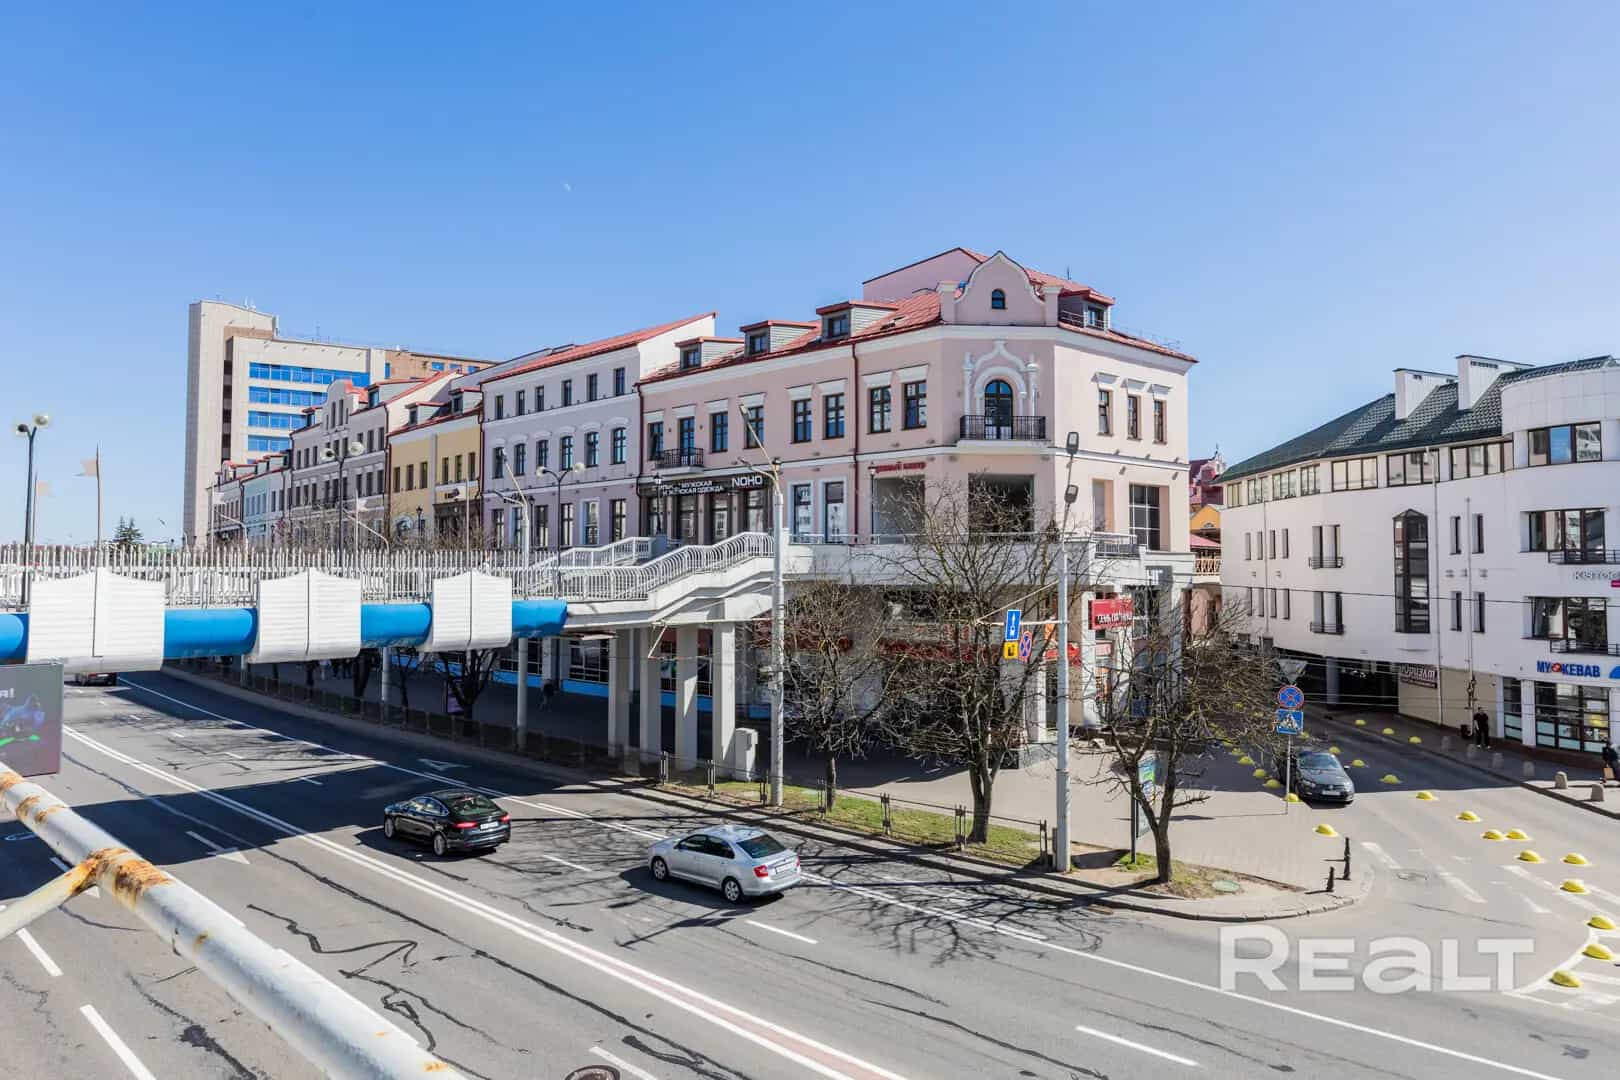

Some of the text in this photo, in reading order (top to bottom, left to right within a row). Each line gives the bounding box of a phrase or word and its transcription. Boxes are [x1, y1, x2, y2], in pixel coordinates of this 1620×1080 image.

[732, 475, 762, 488] NOHO
[1537, 661, 1600, 677] MY KEBAB
